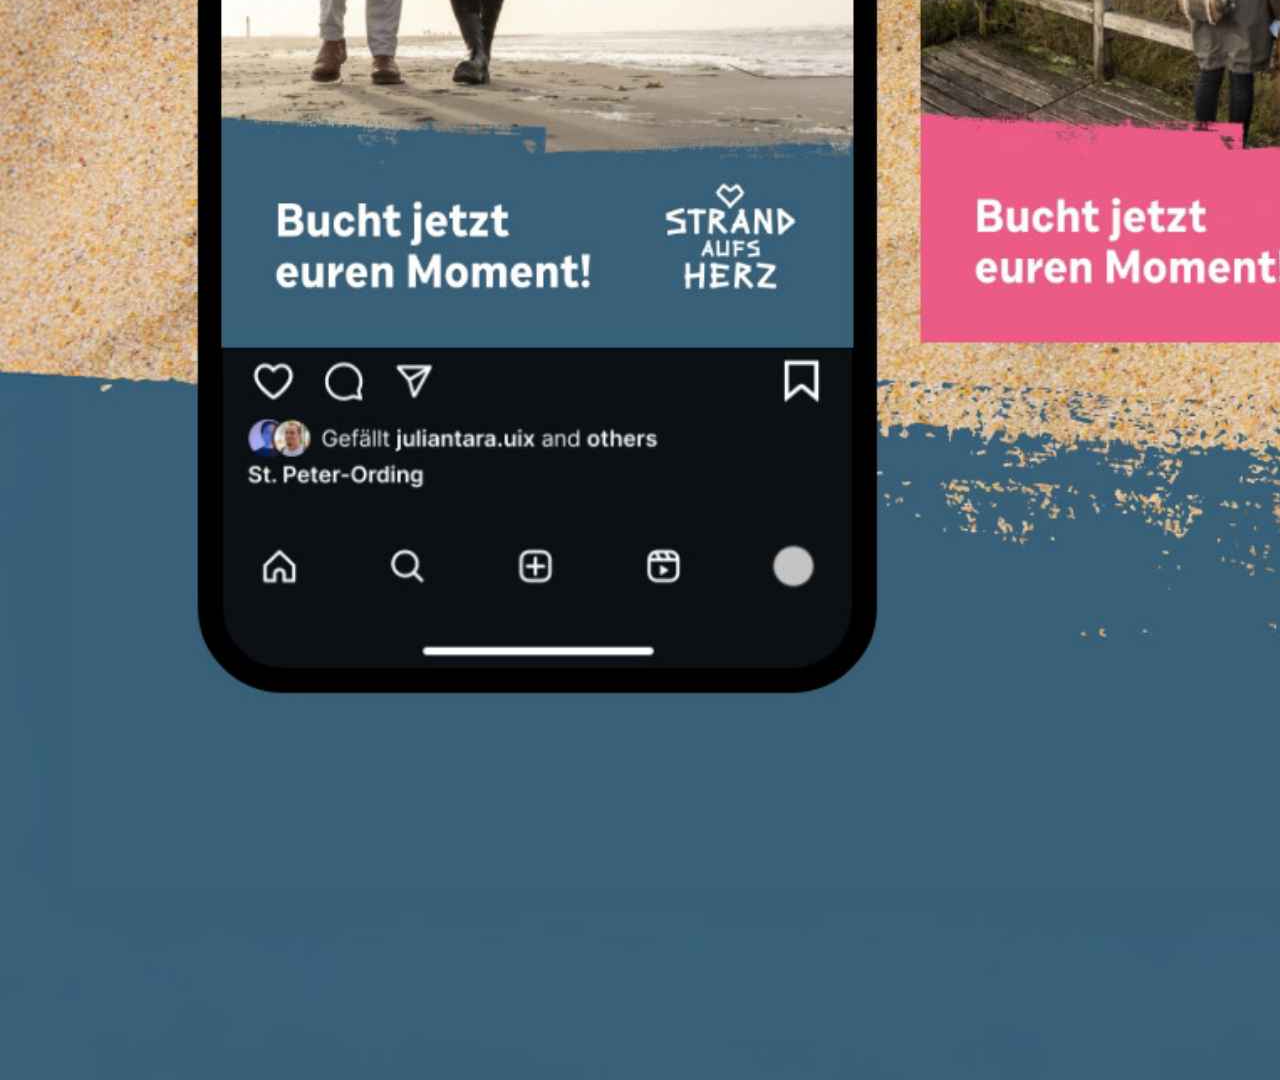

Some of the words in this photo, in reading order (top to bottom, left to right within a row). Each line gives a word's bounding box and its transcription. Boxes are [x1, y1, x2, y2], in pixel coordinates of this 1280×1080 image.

[278, 203, 401, 237] Bucht
[411, 201, 509, 246] jetzt
[666, 208, 795, 235] STRAND
[977, 199, 1099, 232] Bucht
[1109, 198, 1206, 242] jetzt
[701, 240, 760, 257] AUFS
[276, 263, 393, 288] euren
[408, 254, 590, 288] Moment!
[685, 262, 776, 289] HERZ
[976, 258, 1092, 283] euren
[321, 428, 390, 448] Gefällt
[395, 428, 535, 452] juliantara.uix
[541, 429, 581, 448] and
[586, 429, 658, 448] others
[248, 465, 277, 484] St.
[283, 465, 424, 488] Peter-Ording
